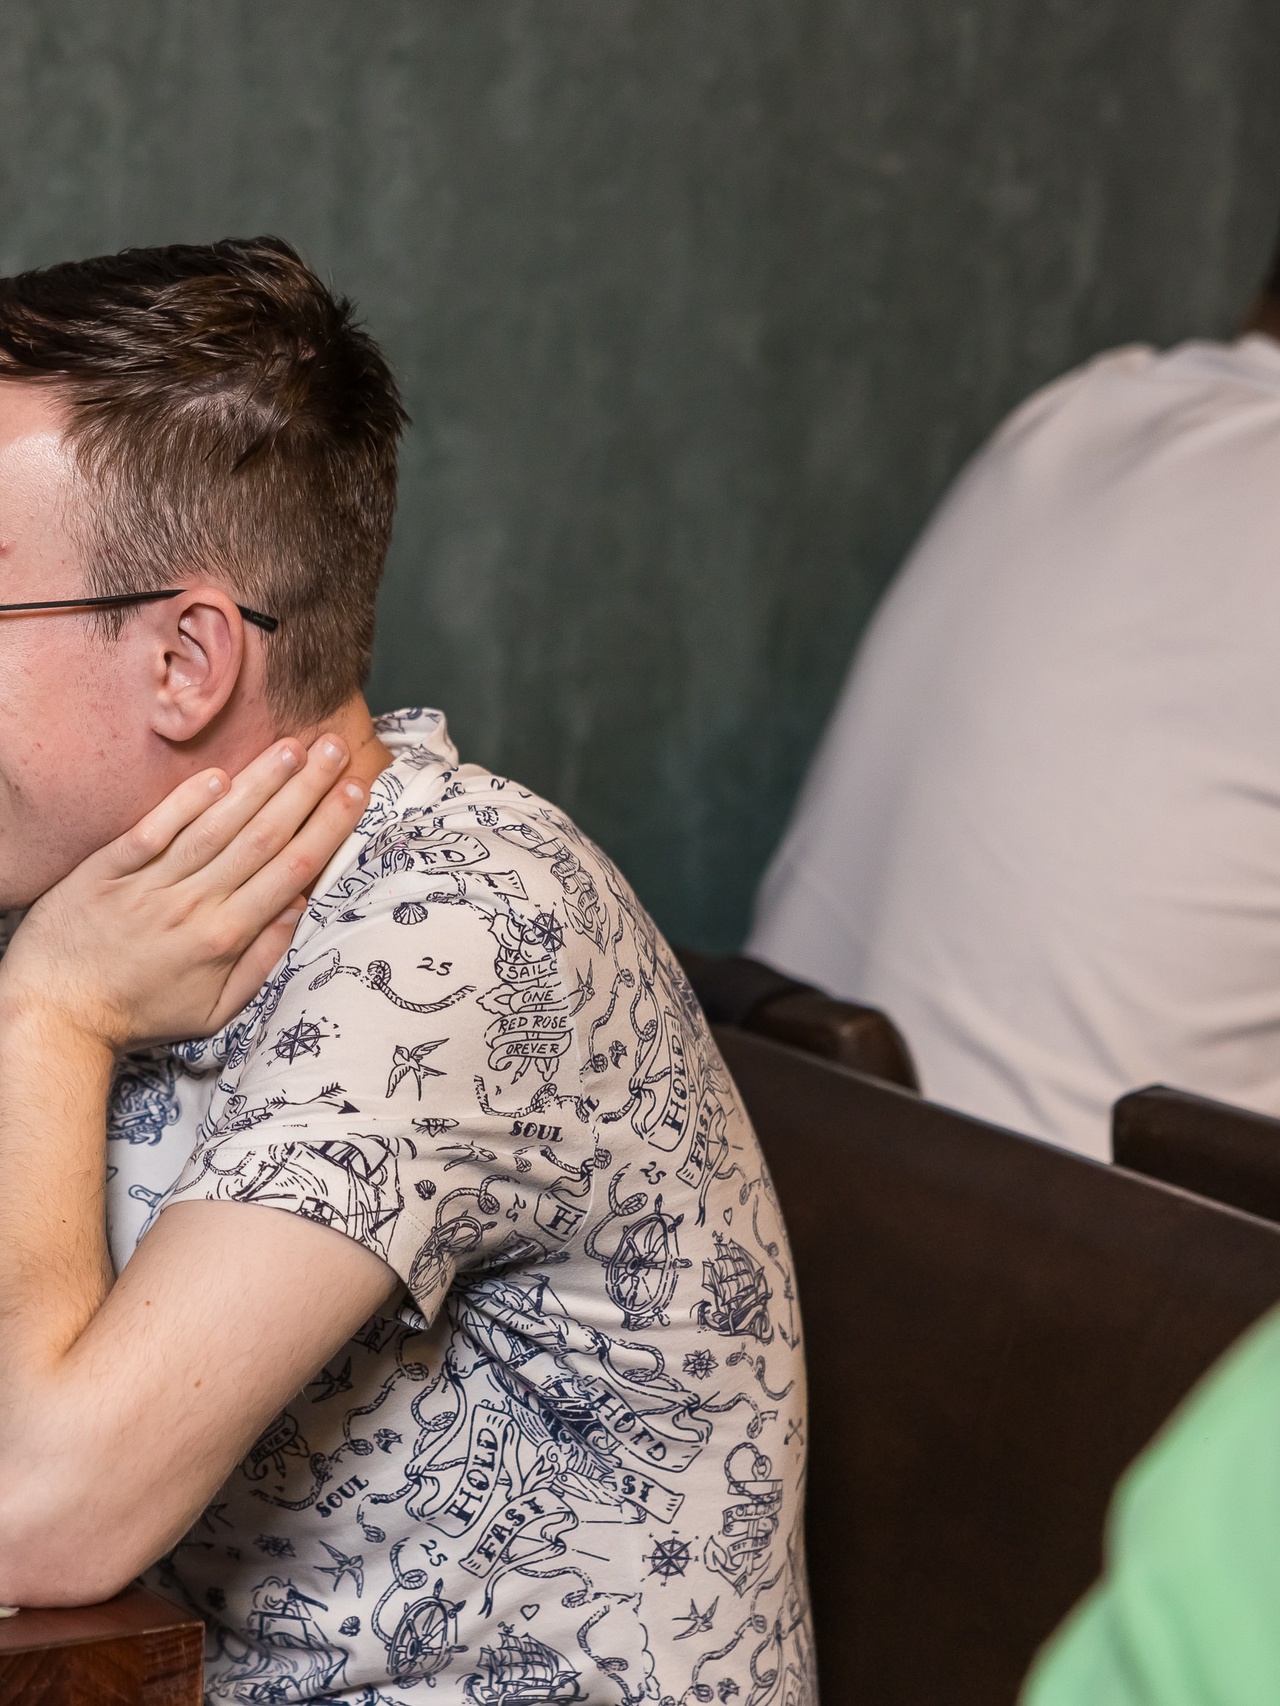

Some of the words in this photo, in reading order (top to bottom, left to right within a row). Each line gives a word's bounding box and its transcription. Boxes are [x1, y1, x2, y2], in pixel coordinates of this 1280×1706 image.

[417, 956, 453, 976] 25
[521, 990, 554, 1004] ONE
[498, 1016, 528, 1034] RED
[533, 1015, 568, 1029] ROSE
[661, 1035, 688, 1137] HOLD
[508, 1120, 564, 1143] SOUL
[639, 1161, 667, 1185] 25
[444, 1428, 498, 1526] HOLD
[315, 1475, 369, 1518] SOUL
[477, 1497, 545, 1563] FAST
[420, 1539, 448, 1567] 25
